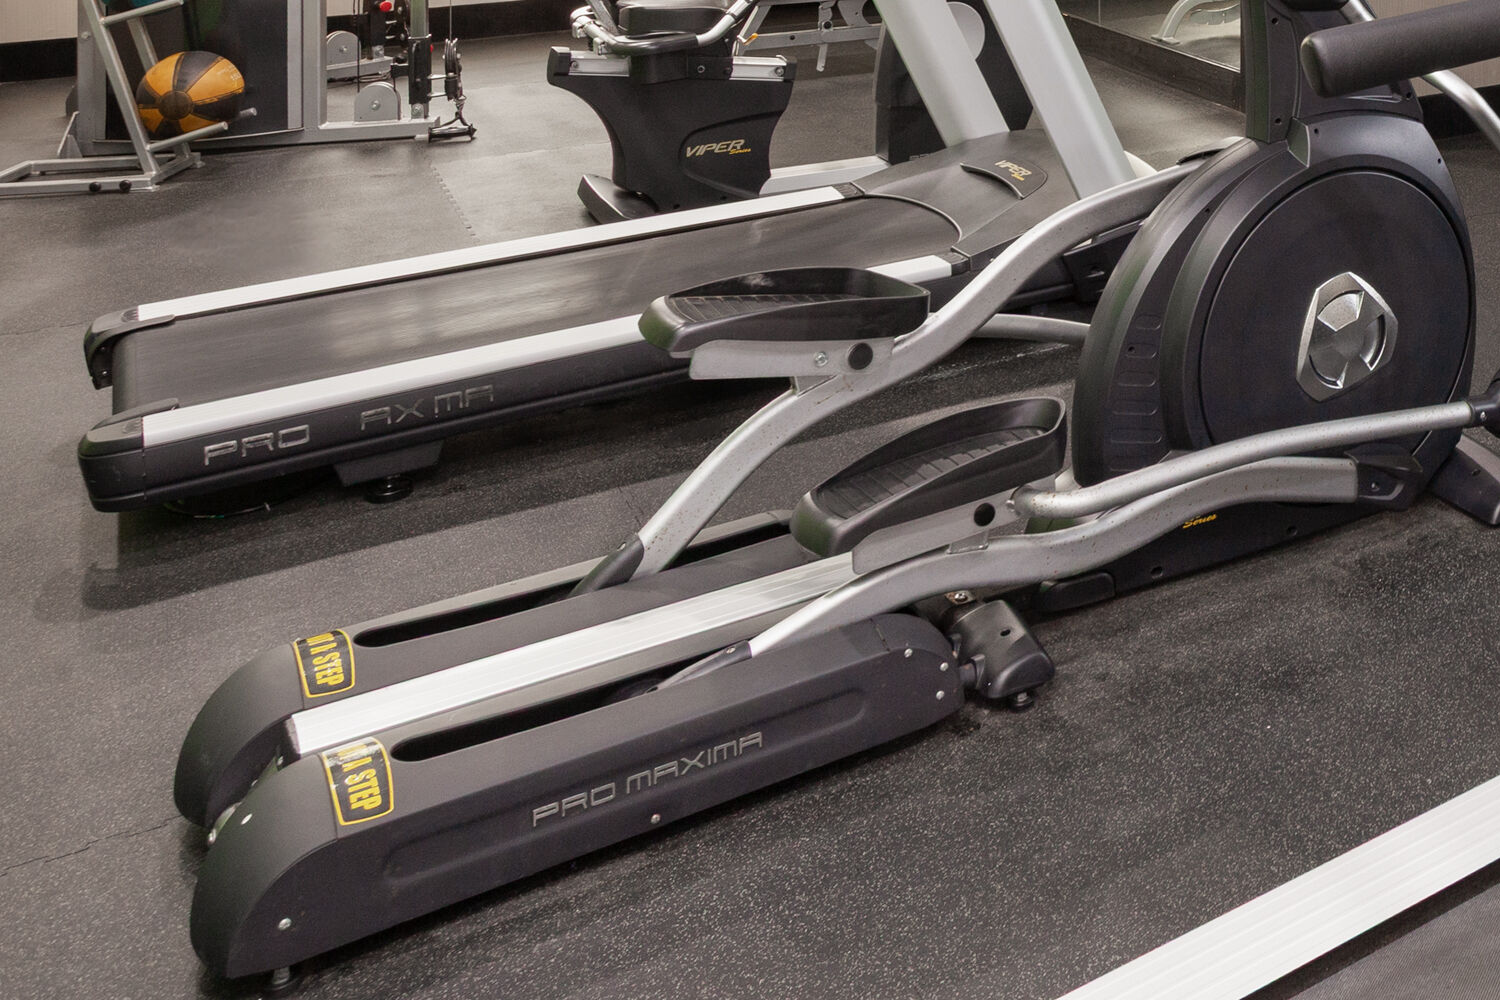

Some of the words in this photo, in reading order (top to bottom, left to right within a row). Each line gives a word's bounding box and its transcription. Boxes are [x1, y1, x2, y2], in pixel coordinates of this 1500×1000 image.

[686, 139, 745, 157] VIPER
[204, 424, 310, 466] PRO
[312, 651, 345, 686] STEP
[344, 768, 382, 810] STEP
[532, 782, 616, 828] PRO
[626, 731, 762, 794] MAXIMA
